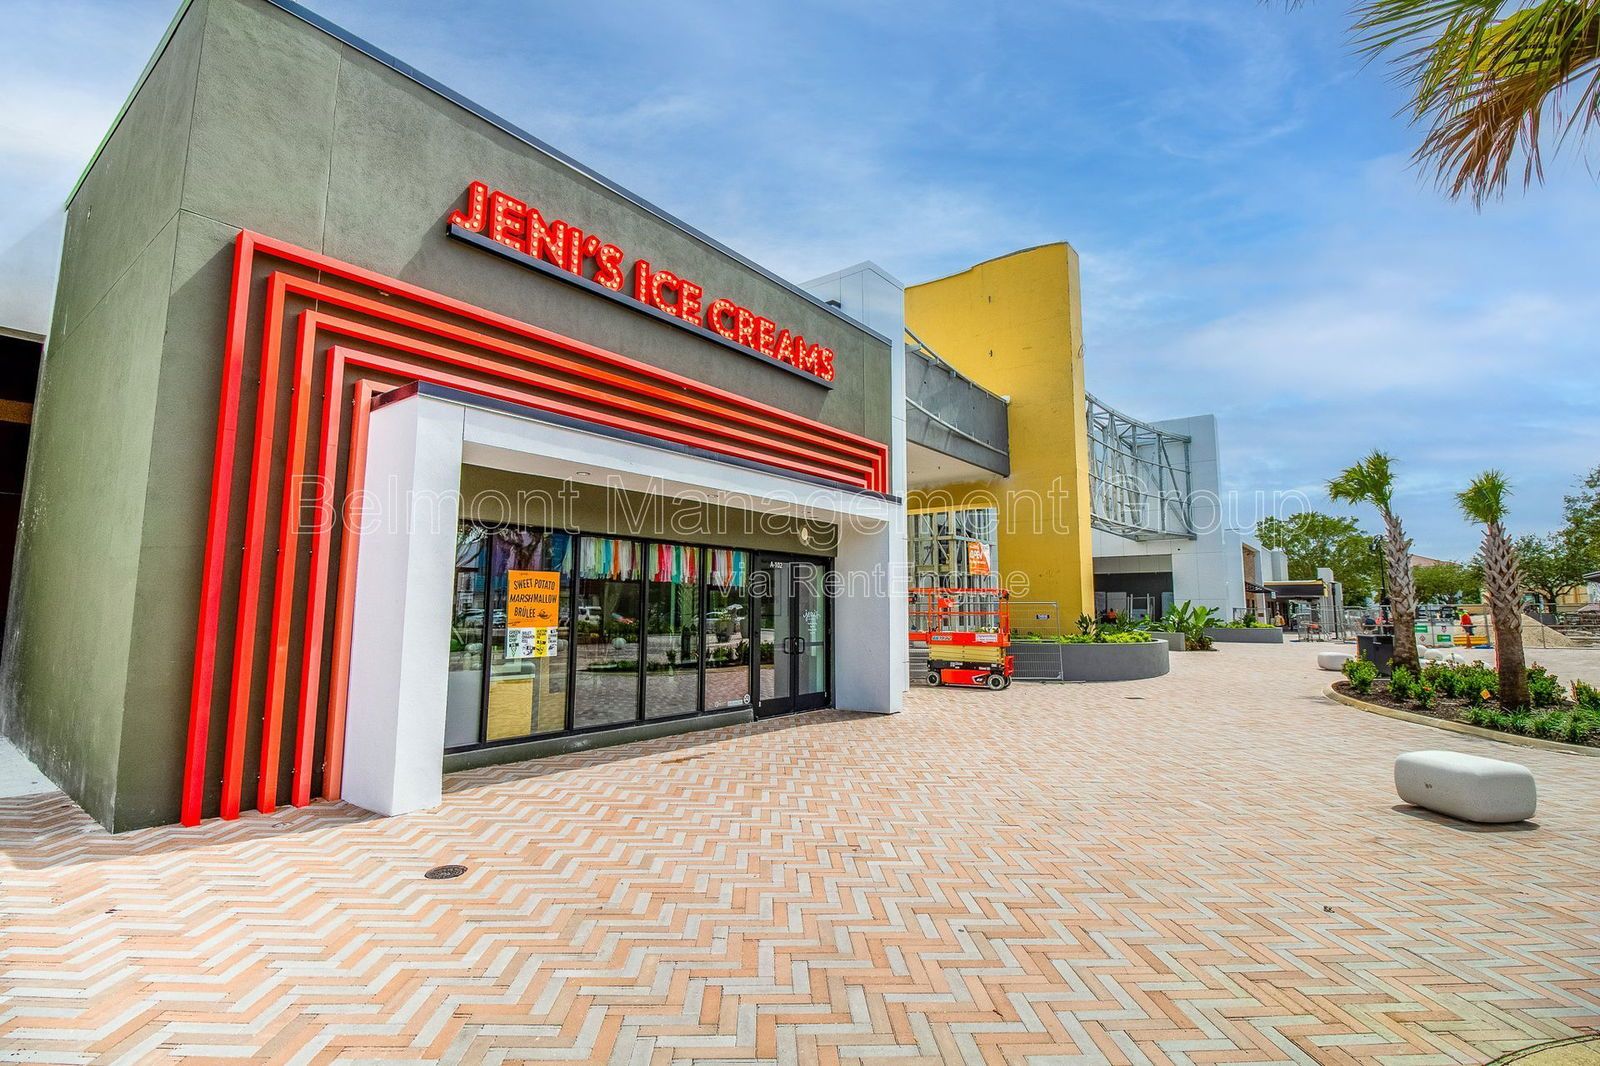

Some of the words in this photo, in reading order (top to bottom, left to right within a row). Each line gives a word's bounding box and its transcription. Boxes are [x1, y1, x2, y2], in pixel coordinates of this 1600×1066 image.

[447, 181, 625, 292] JENI'S
[634, 259, 703, 326] ICE
[707, 298, 836, 383] CREAMS
[769, 561, 783, 569] A-102
[513, 578, 533, 591] SWEET
[534, 578, 556, 591] POTATO
[510, 593, 557, 604] MARSHMALLOW
